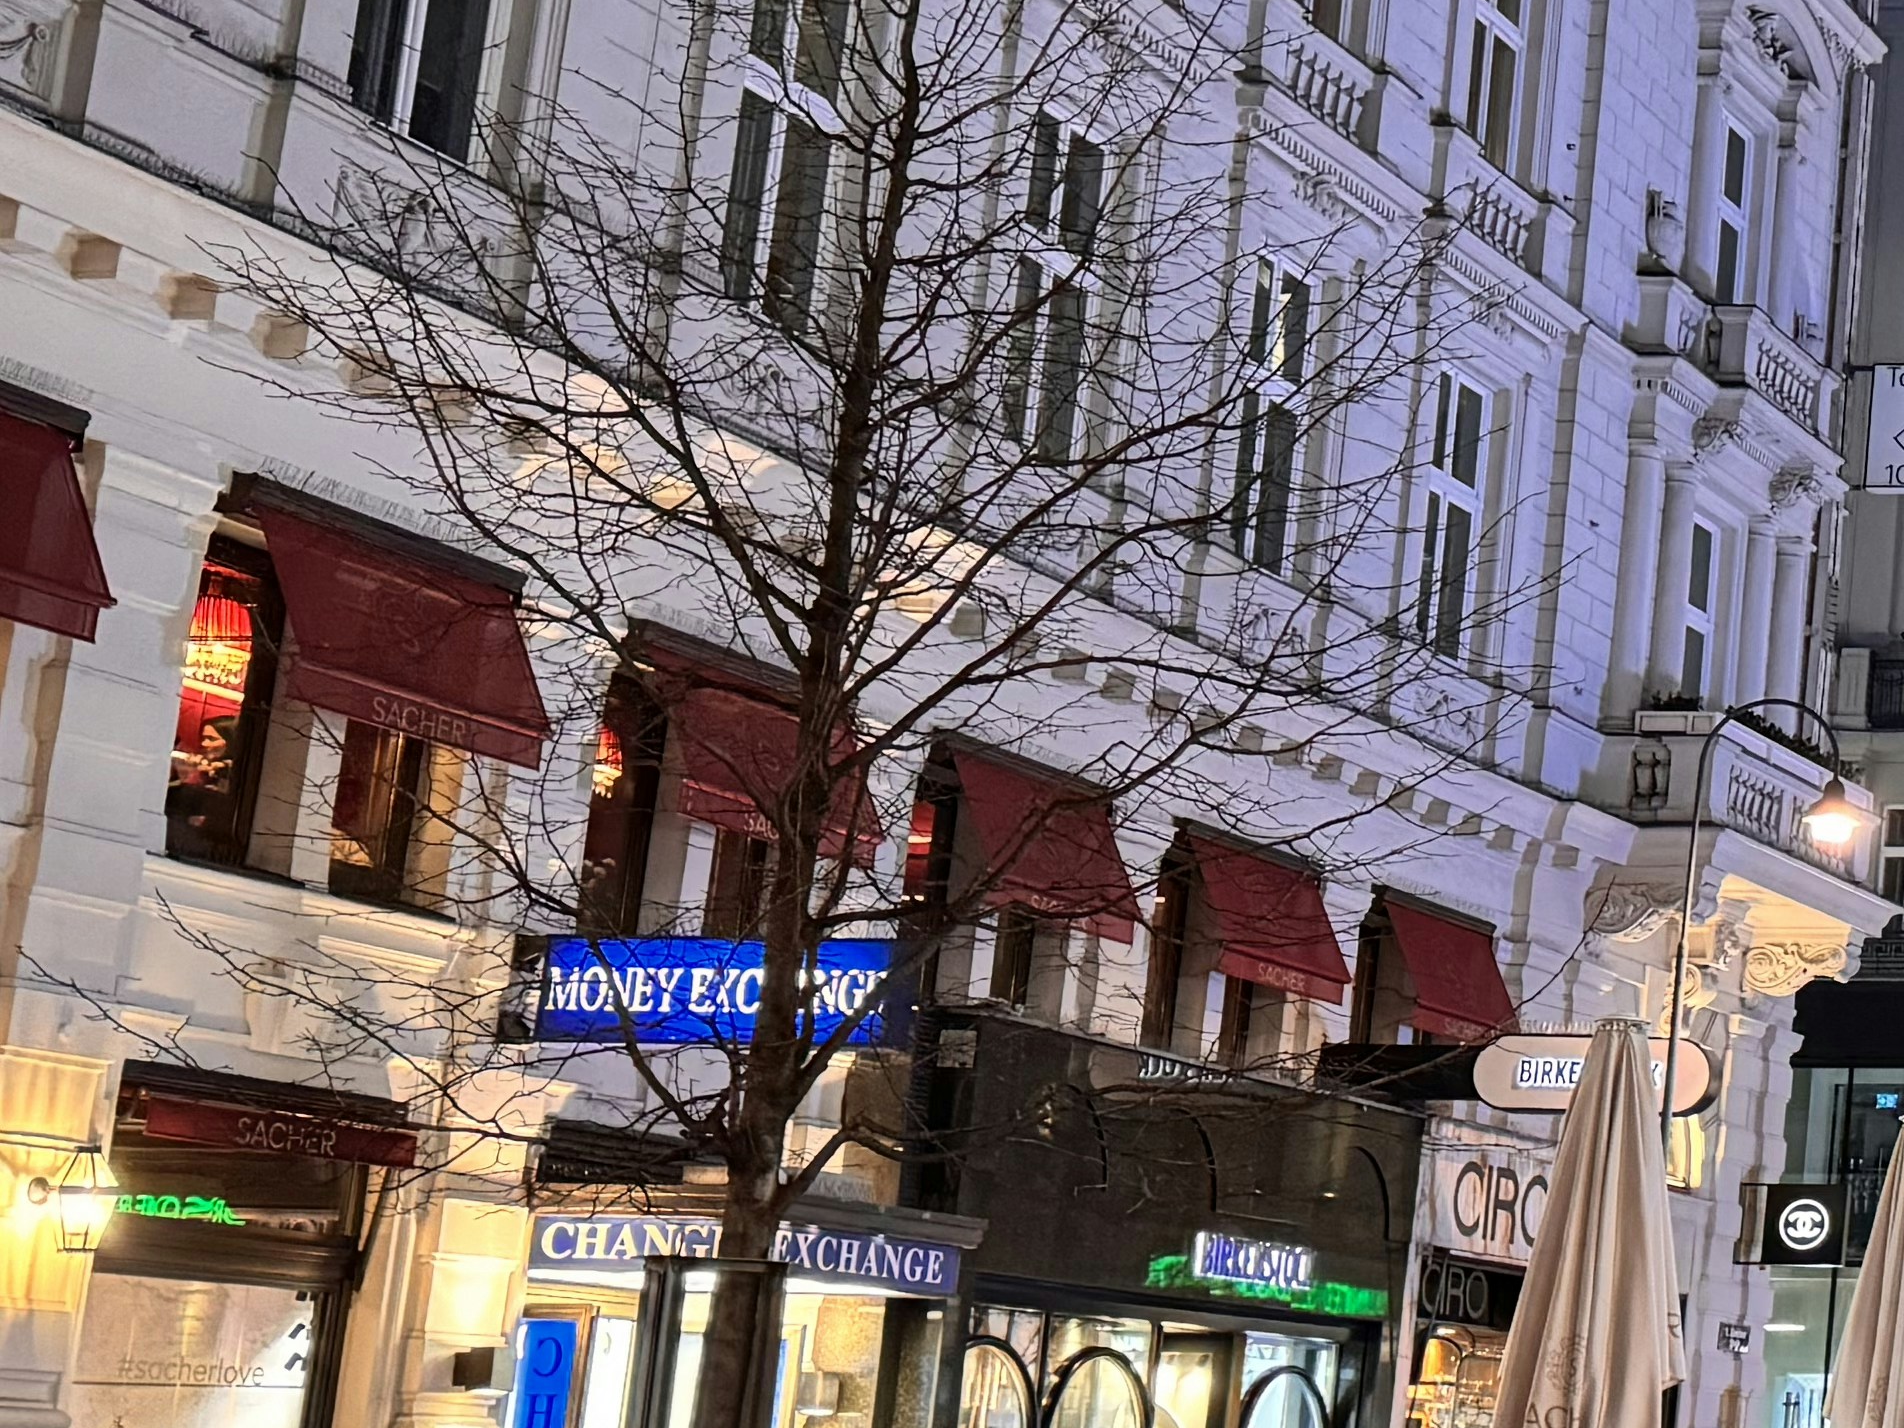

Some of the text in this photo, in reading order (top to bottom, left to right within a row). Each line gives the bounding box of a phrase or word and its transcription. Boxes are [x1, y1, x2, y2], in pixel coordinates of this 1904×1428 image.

[370, 694, 468, 746] SACHER
[544, 965, 680, 1013] MONEY
[234, 1117, 337, 1156] SACHER
[773, 1229, 945, 1284] EXCHANGE
[1421, 1260, 1489, 1320] CIRO
[118, 1354, 266, 1388] #sacherlove
